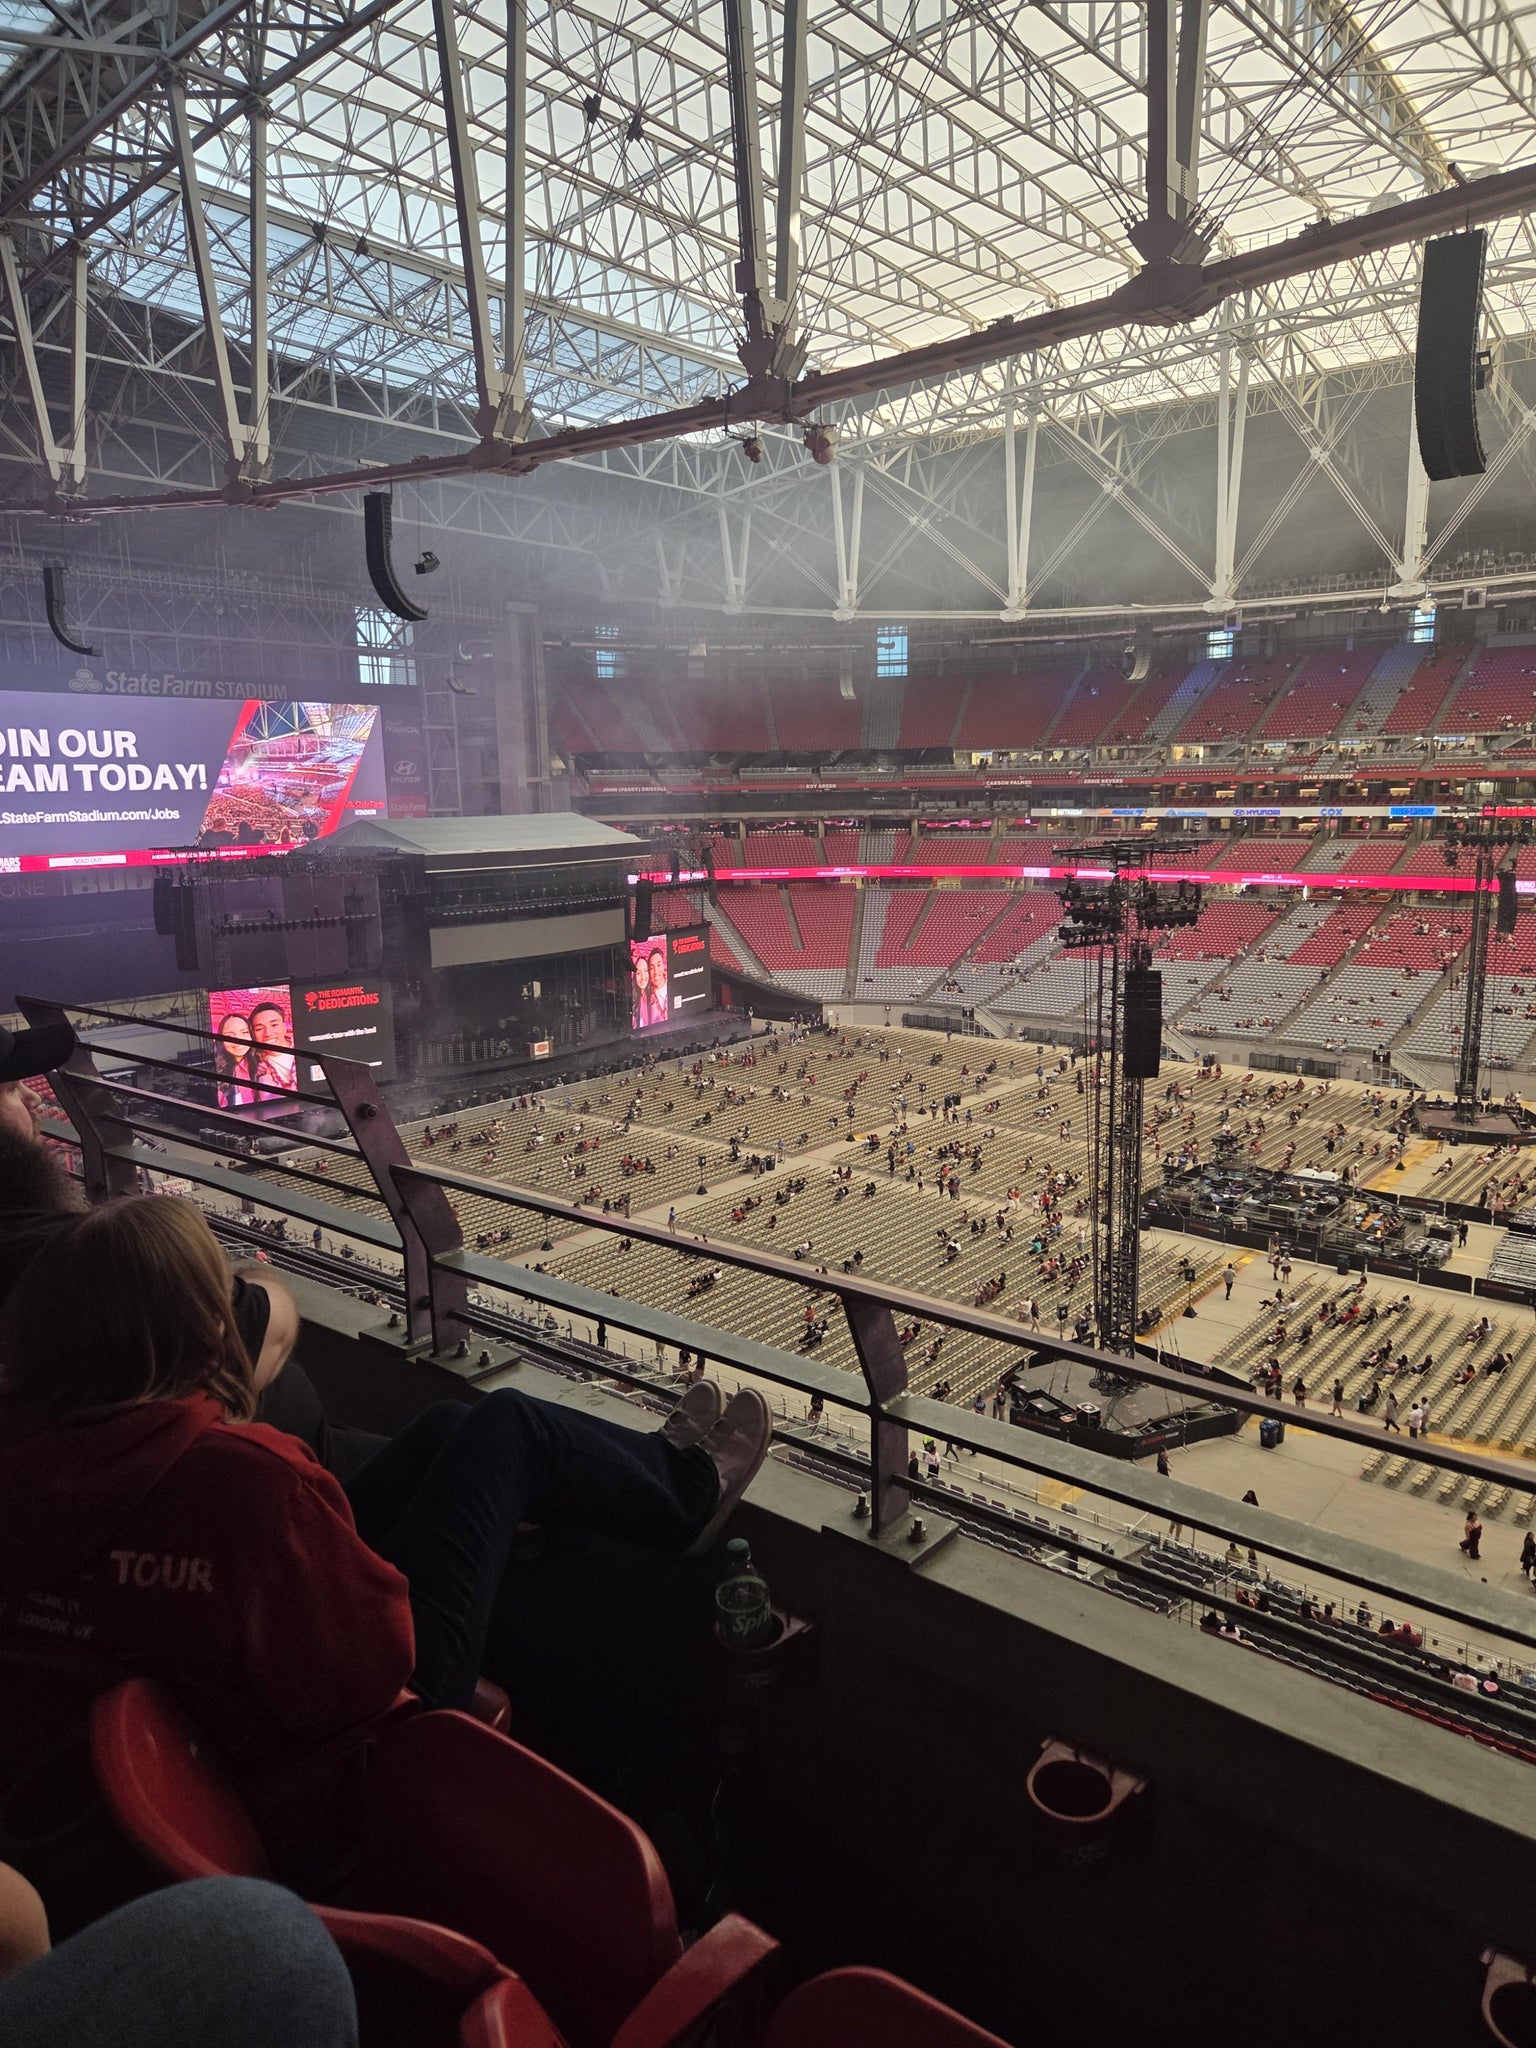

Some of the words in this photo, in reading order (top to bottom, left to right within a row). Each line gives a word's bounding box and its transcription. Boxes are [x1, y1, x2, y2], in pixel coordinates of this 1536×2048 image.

[215, 680, 287, 700] STADIUM
[0, 728, 52, 758] IN
[58, 729, 139, 758] OUR
[73, 763, 208, 792] TODAY!
[1320, 808, 1343, 816] COX
[319, 990, 330, 998] THE
[332, 987, 364, 997] ROMANTIC
[319, 994, 379, 1010] DEDICATIONS
[110, 1550, 214, 1592] TOUR
